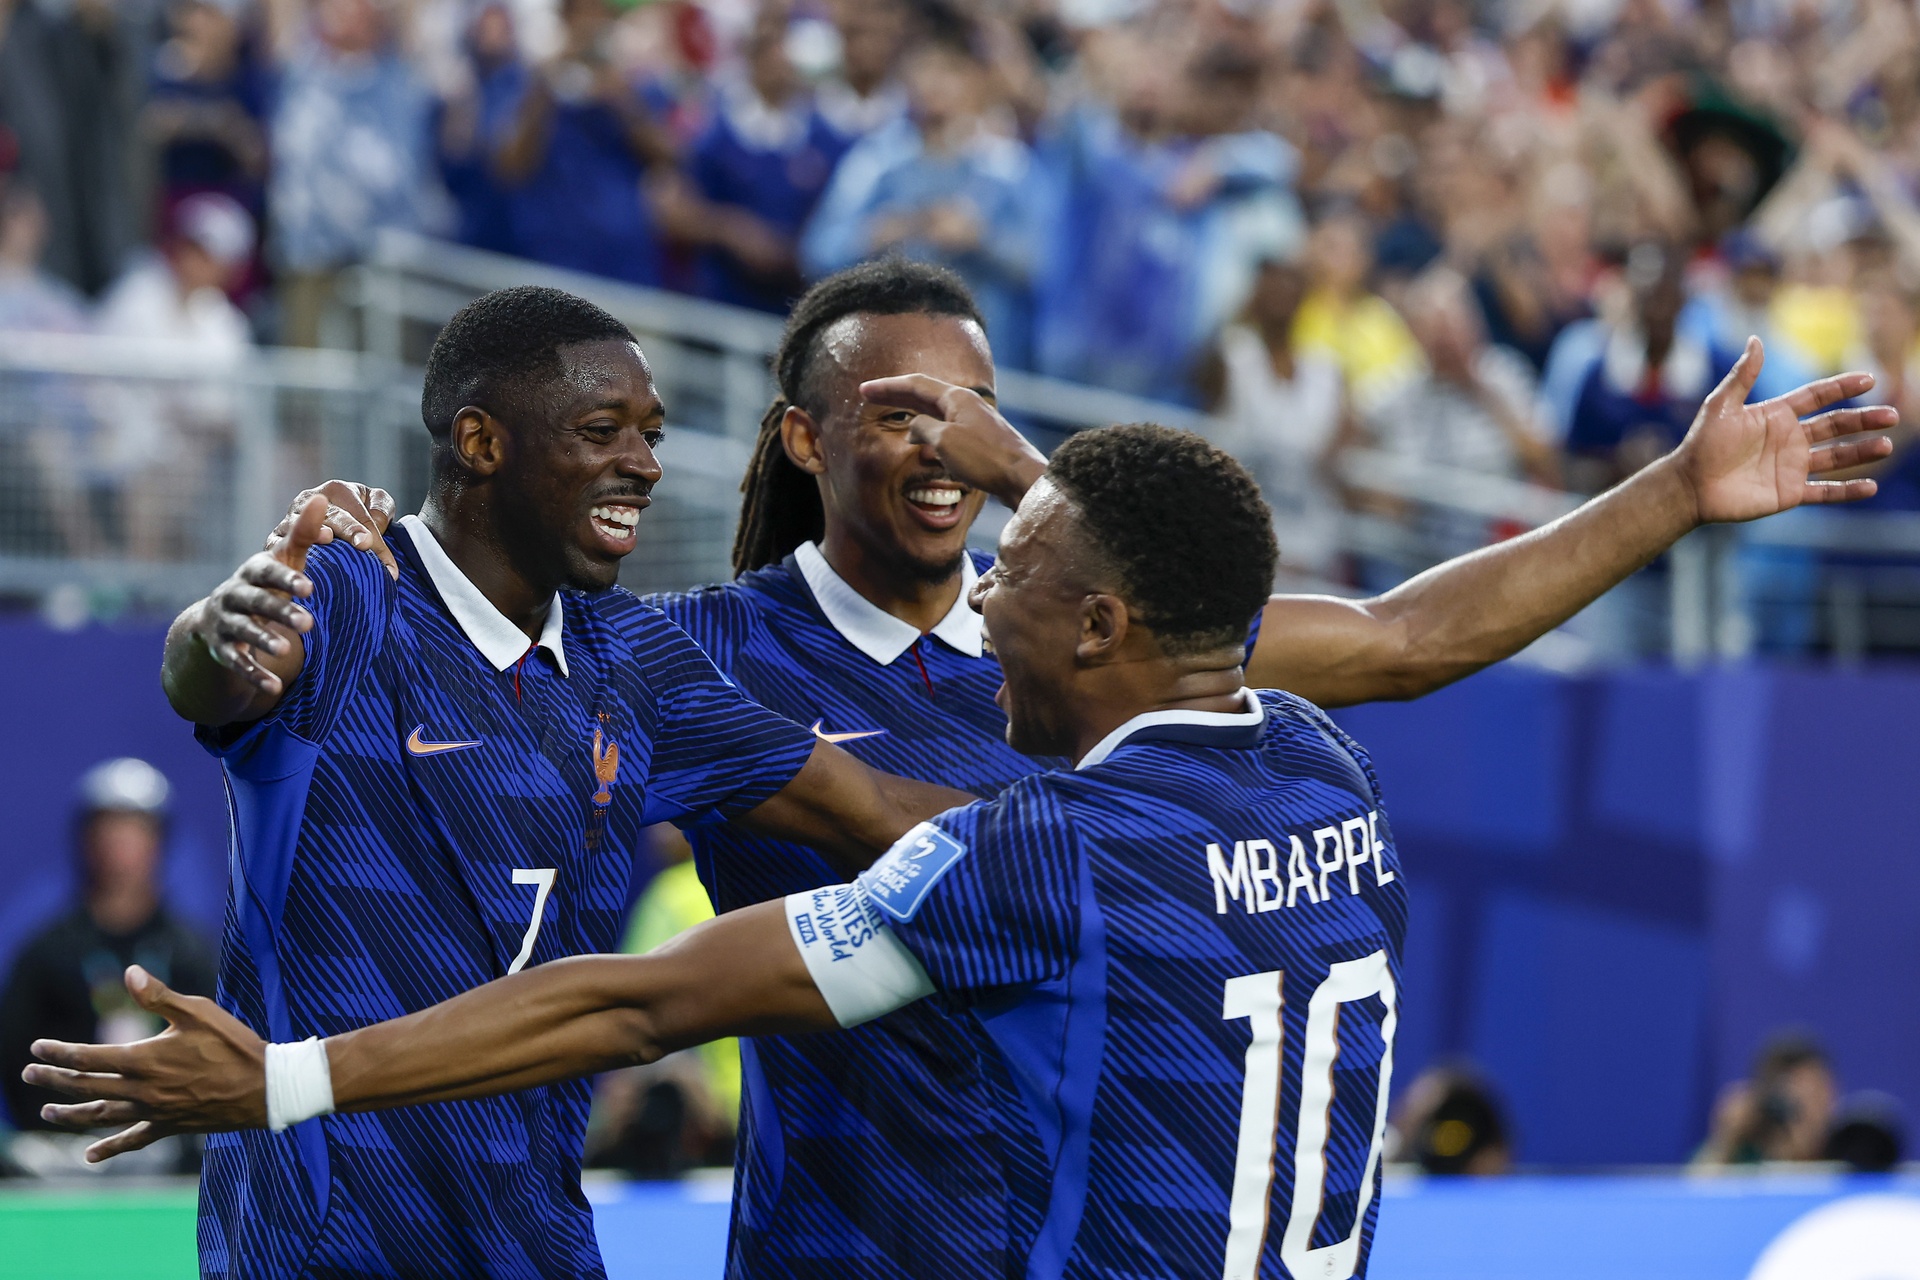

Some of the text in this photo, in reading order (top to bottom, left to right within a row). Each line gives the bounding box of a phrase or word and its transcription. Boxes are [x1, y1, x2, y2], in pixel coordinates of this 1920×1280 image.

[876, 864, 910, 894] PEACE
[1206, 810, 1395, 914] MBAPPE
[507, 868, 558, 976] 7
[812, 888, 853, 962] the World
[835, 887, 873, 948] UNITES
[1222, 949, 1397, 1280] 10
